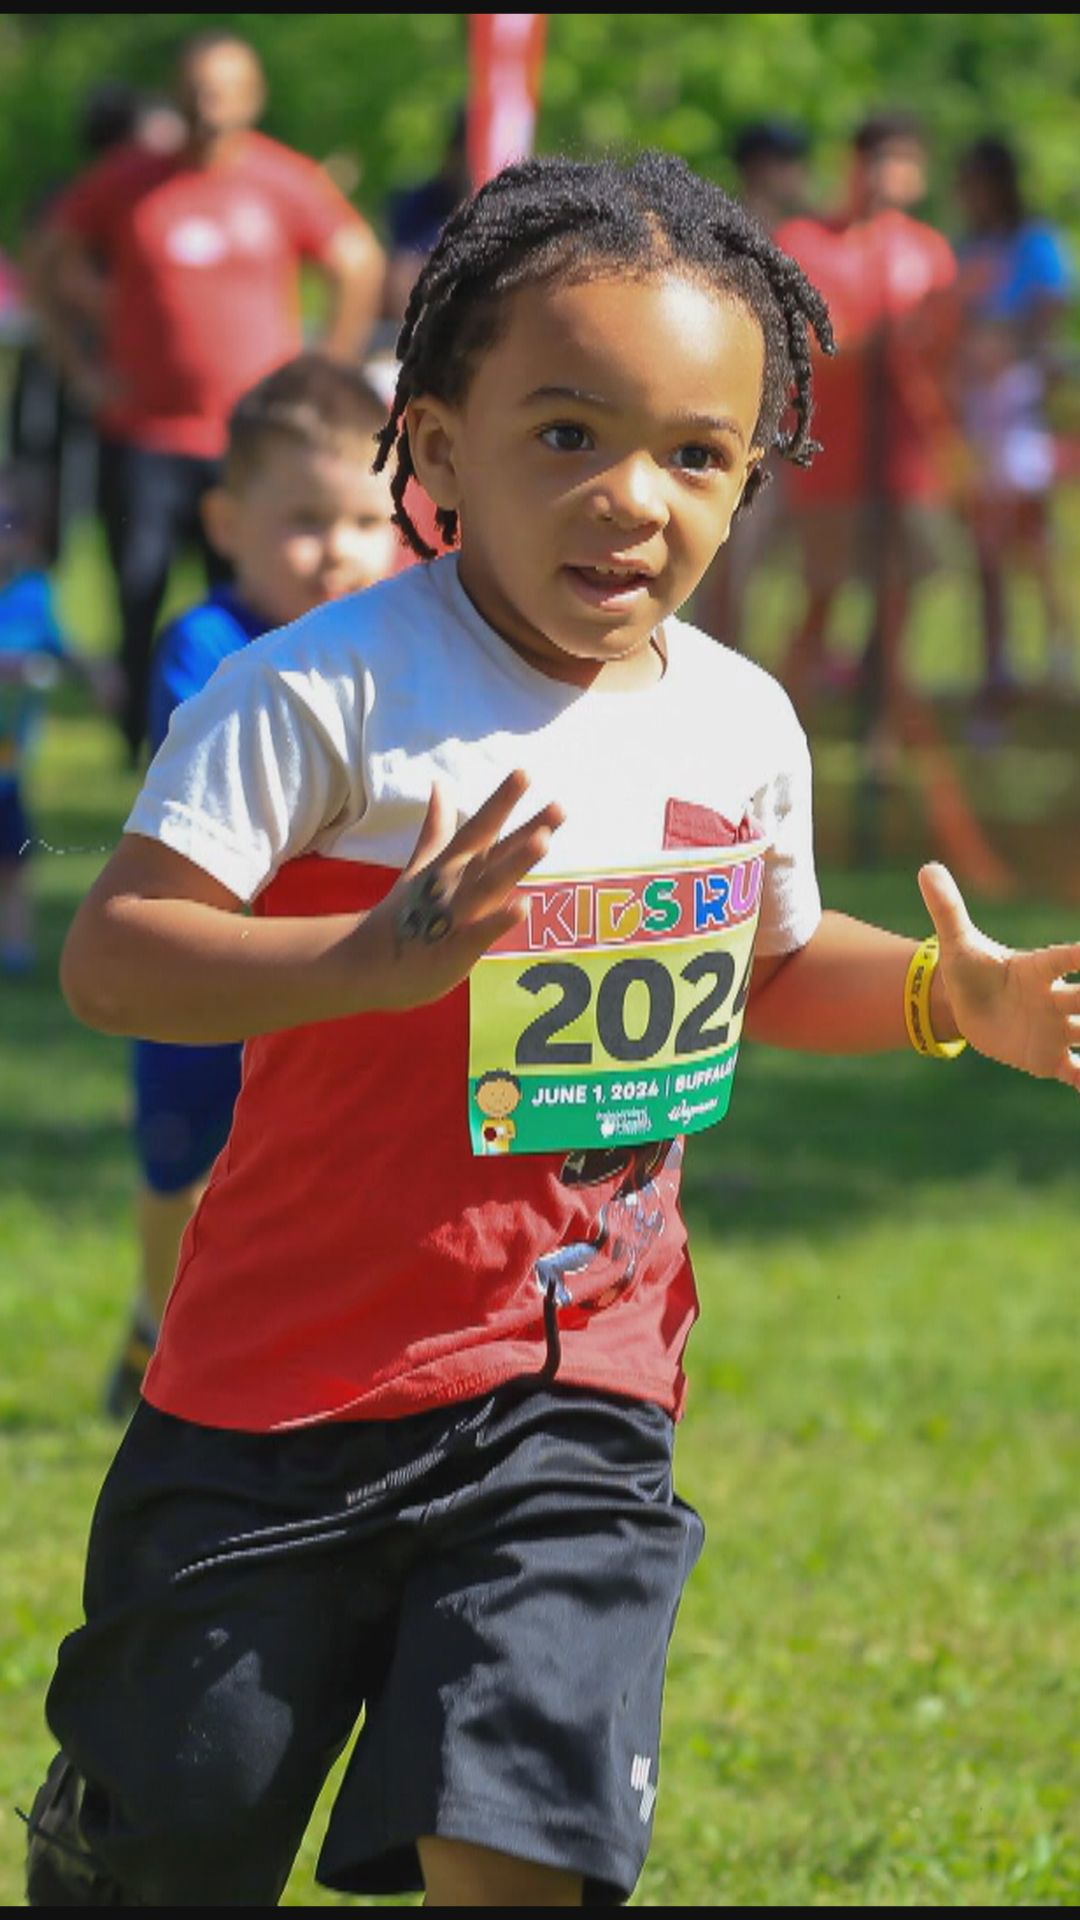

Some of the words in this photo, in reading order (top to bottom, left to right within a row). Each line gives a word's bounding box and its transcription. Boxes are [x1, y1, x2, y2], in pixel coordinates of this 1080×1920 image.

[528, 879, 683, 950] KIDS
[694, 856, 765, 932] RU
[531, 1084, 588, 1107] JUNE
[593, 1085, 606, 1104] 1,
[610, 1079, 660, 1101] 2024
